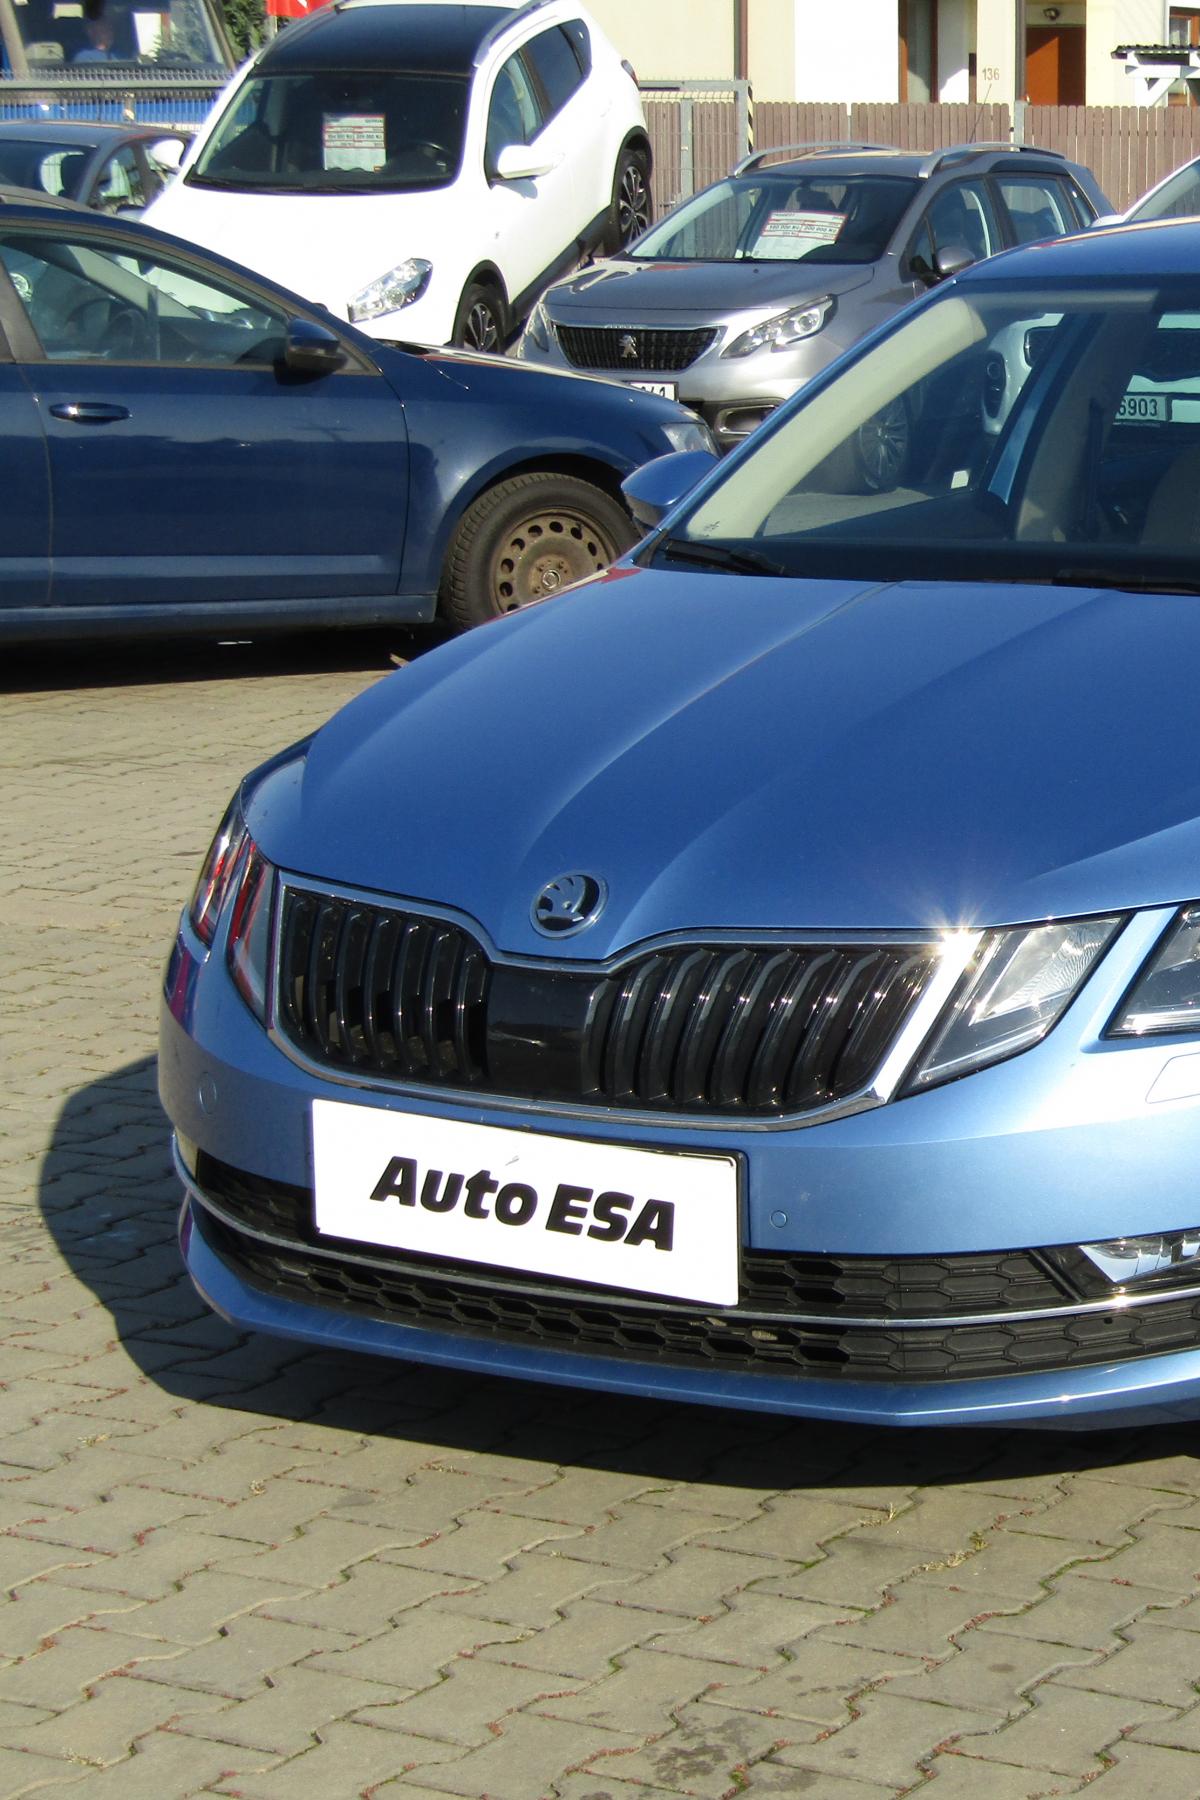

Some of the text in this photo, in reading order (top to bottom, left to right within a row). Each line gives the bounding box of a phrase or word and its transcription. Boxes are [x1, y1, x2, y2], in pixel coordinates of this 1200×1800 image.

[982, 67, 999, 80] 136
[370, 1156, 675, 1251] Auto ESA
